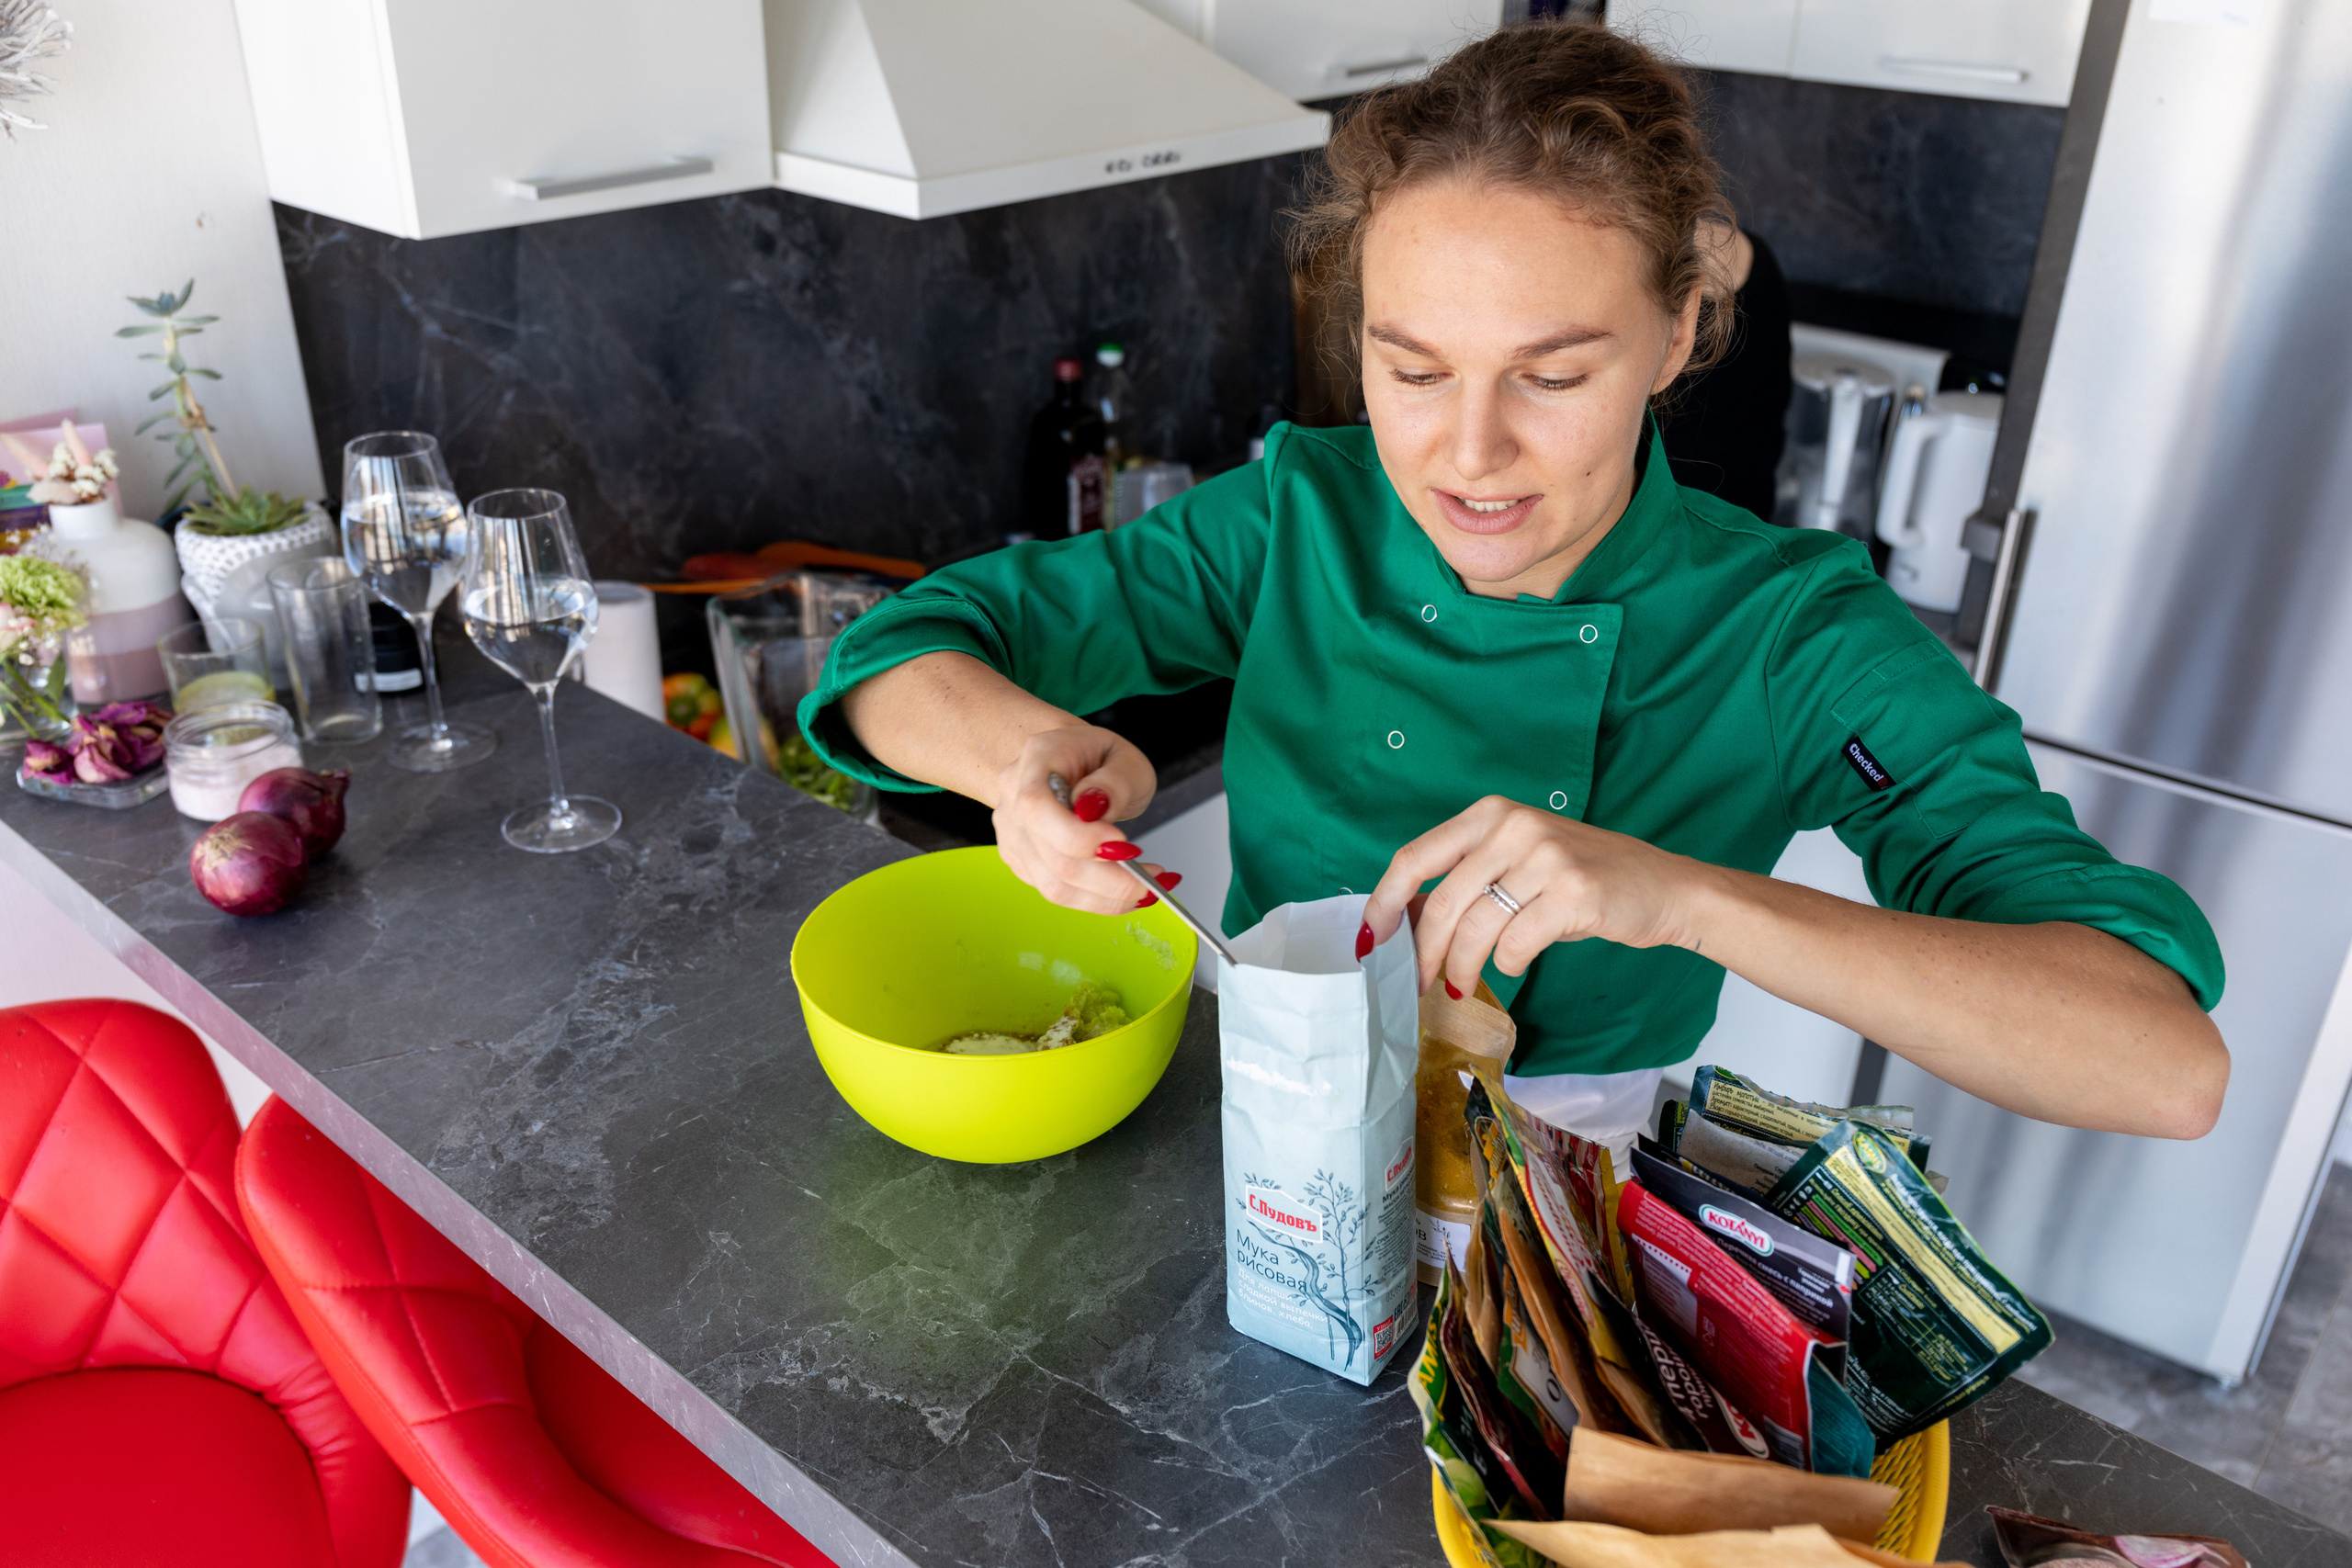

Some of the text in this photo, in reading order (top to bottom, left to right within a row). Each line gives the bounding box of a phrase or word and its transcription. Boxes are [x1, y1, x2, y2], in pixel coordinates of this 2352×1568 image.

[1849, 743, 1885, 783] Checked
[1249, 1194, 1317, 1233] С.Пудовъ
[1708, 1211, 1765, 1249] KOTÁNYI
[1236, 1229, 1279, 1266] Мука
[1237, 1248, 1307, 1292] рисовая
[1238, 1268, 1296, 1304] Для лапши,
[1757, 1259, 1782, 1279] смесь
[1238, 1280, 1332, 1325] сладкой выпечки,
[1238, 1290, 1314, 1329] блинов, хлеба.
[1419, 1315, 1439, 1395] AMIS
